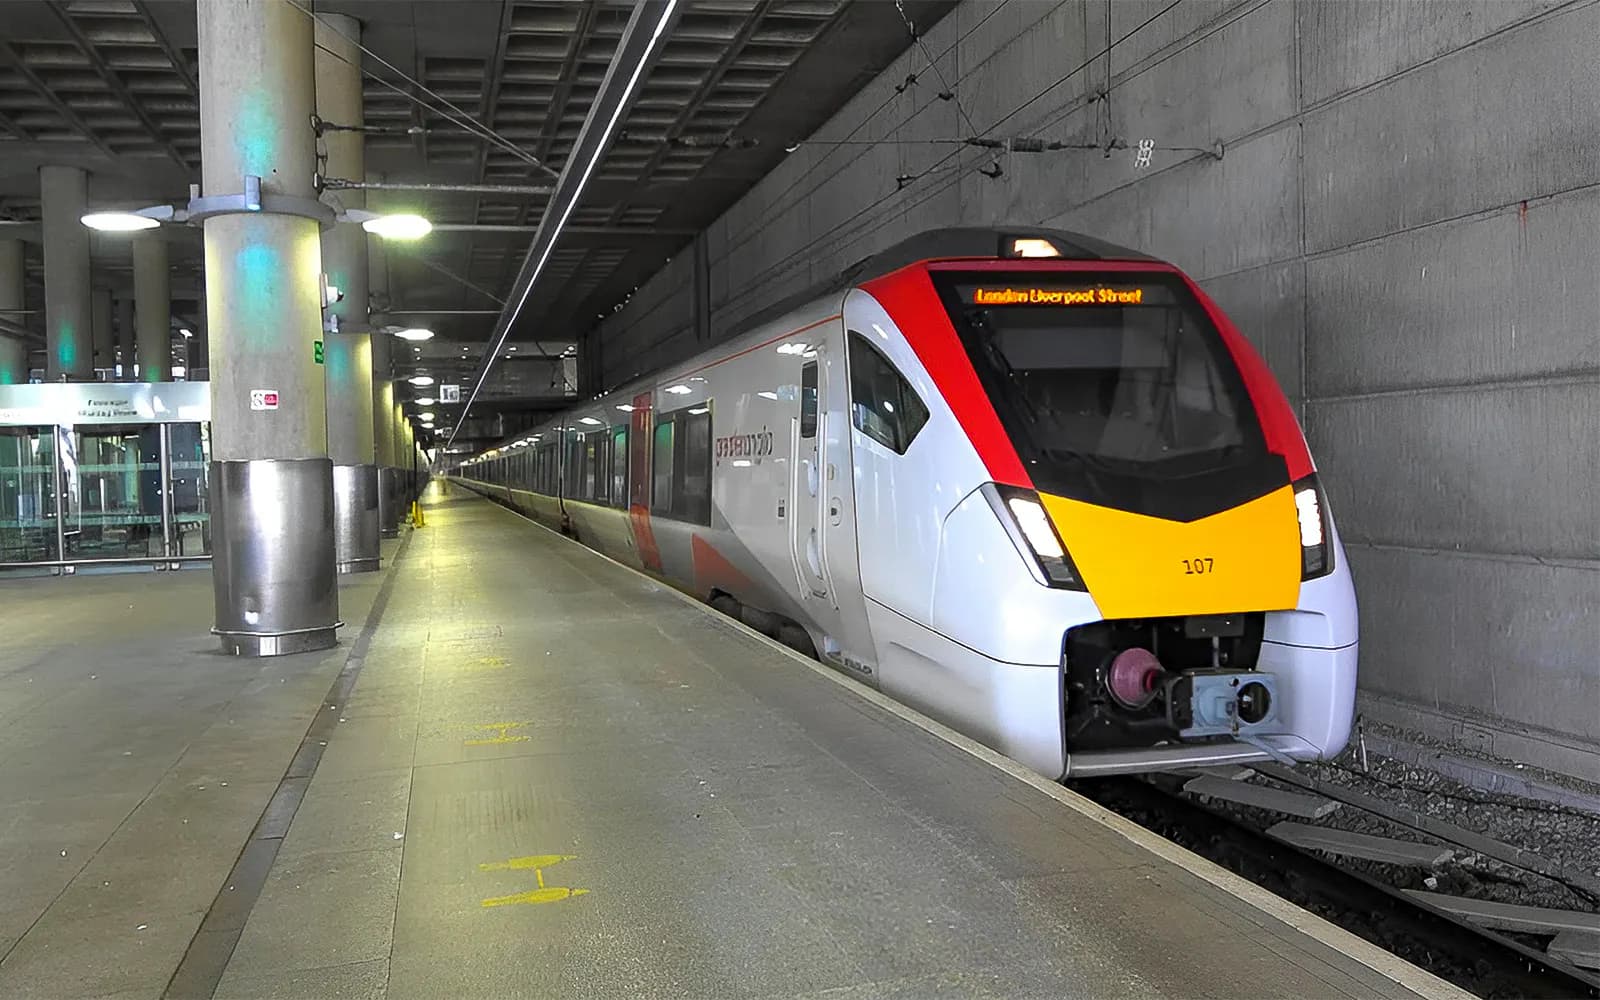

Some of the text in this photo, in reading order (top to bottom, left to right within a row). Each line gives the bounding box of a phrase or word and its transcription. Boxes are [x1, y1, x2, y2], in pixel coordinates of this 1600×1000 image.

[976, 288, 1142, 304] London Liverpool Street
[1182, 557, 1214, 575] 107
